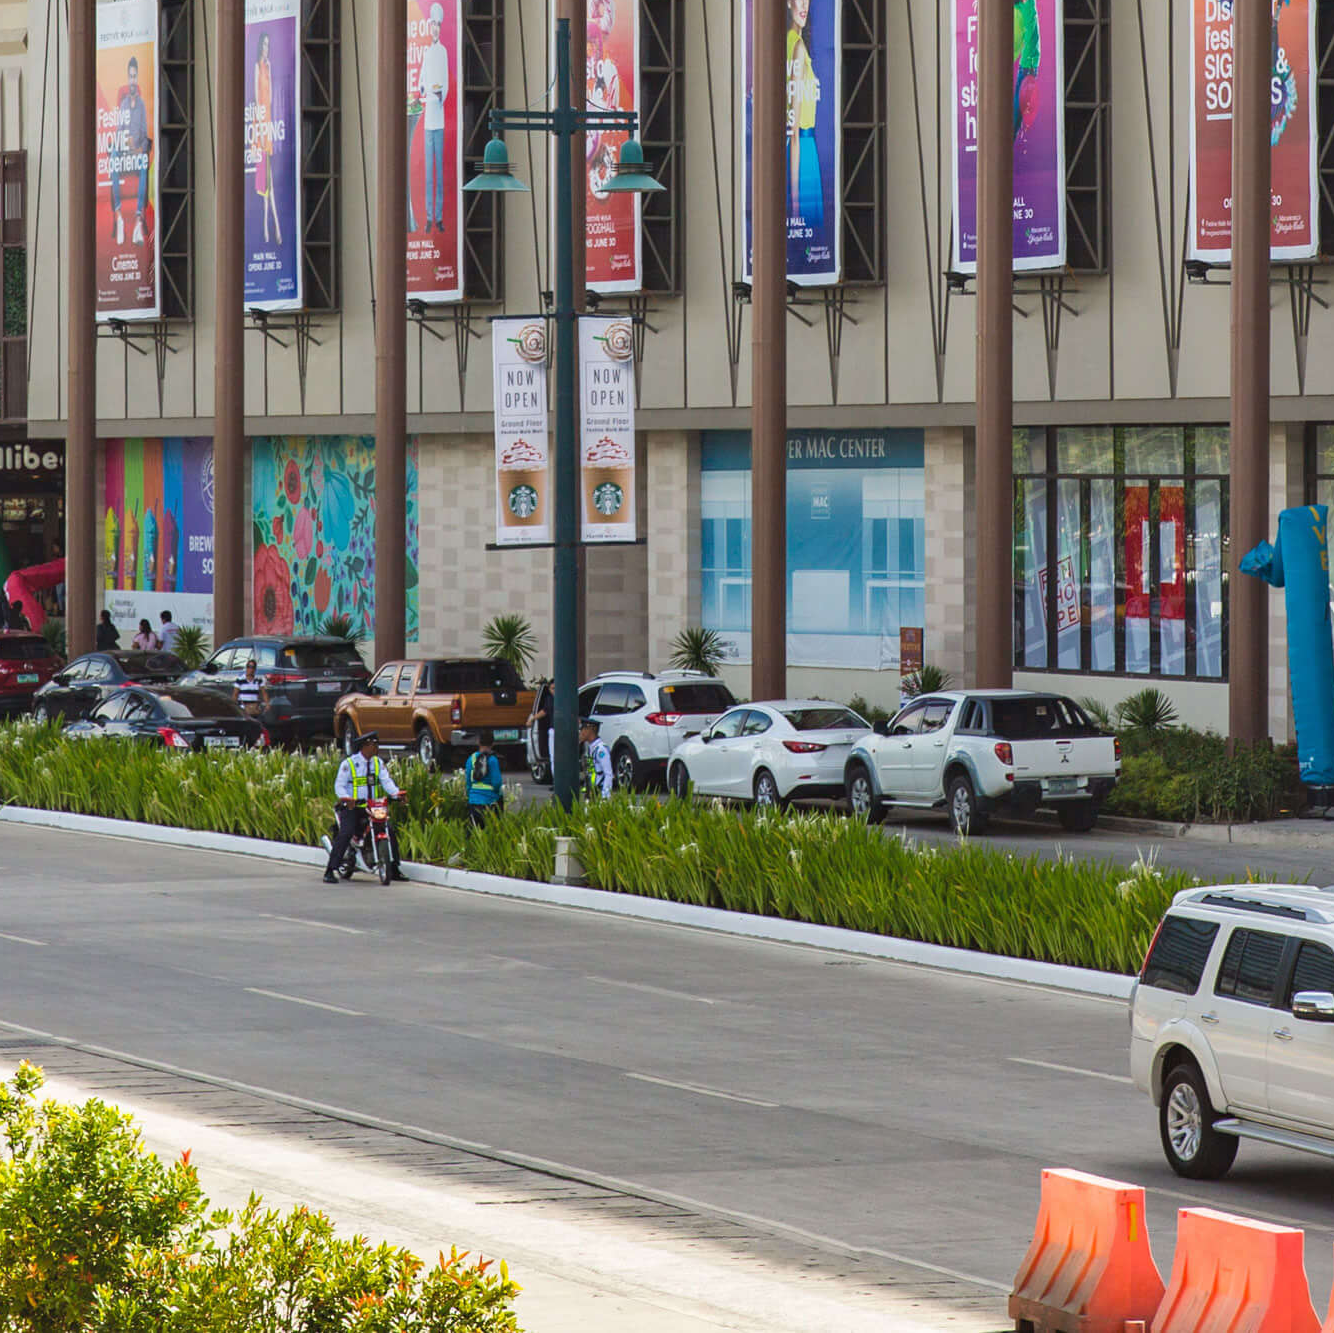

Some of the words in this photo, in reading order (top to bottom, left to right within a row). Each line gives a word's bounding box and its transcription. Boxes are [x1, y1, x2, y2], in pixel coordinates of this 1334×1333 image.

[98, 106, 131, 128] Festive
[244, 102, 267, 123] stive
[97, 129, 131, 154] MOVIE
[98, 152, 149, 179] experience
[1013, 196, 1026, 207] ALL
[1271, 195, 1282, 206] 30
[507, 370, 534, 387] NOW
[593, 368, 622, 385] NOW
[505, 392, 539, 409] OPEN
[591, 390, 625, 406] OPEN
[805, 436, 836, 459] MAC
[839, 438, 885, 458] CENTER
[812, 495, 829, 507] MAC
[189, 535, 215, 553] BREW
